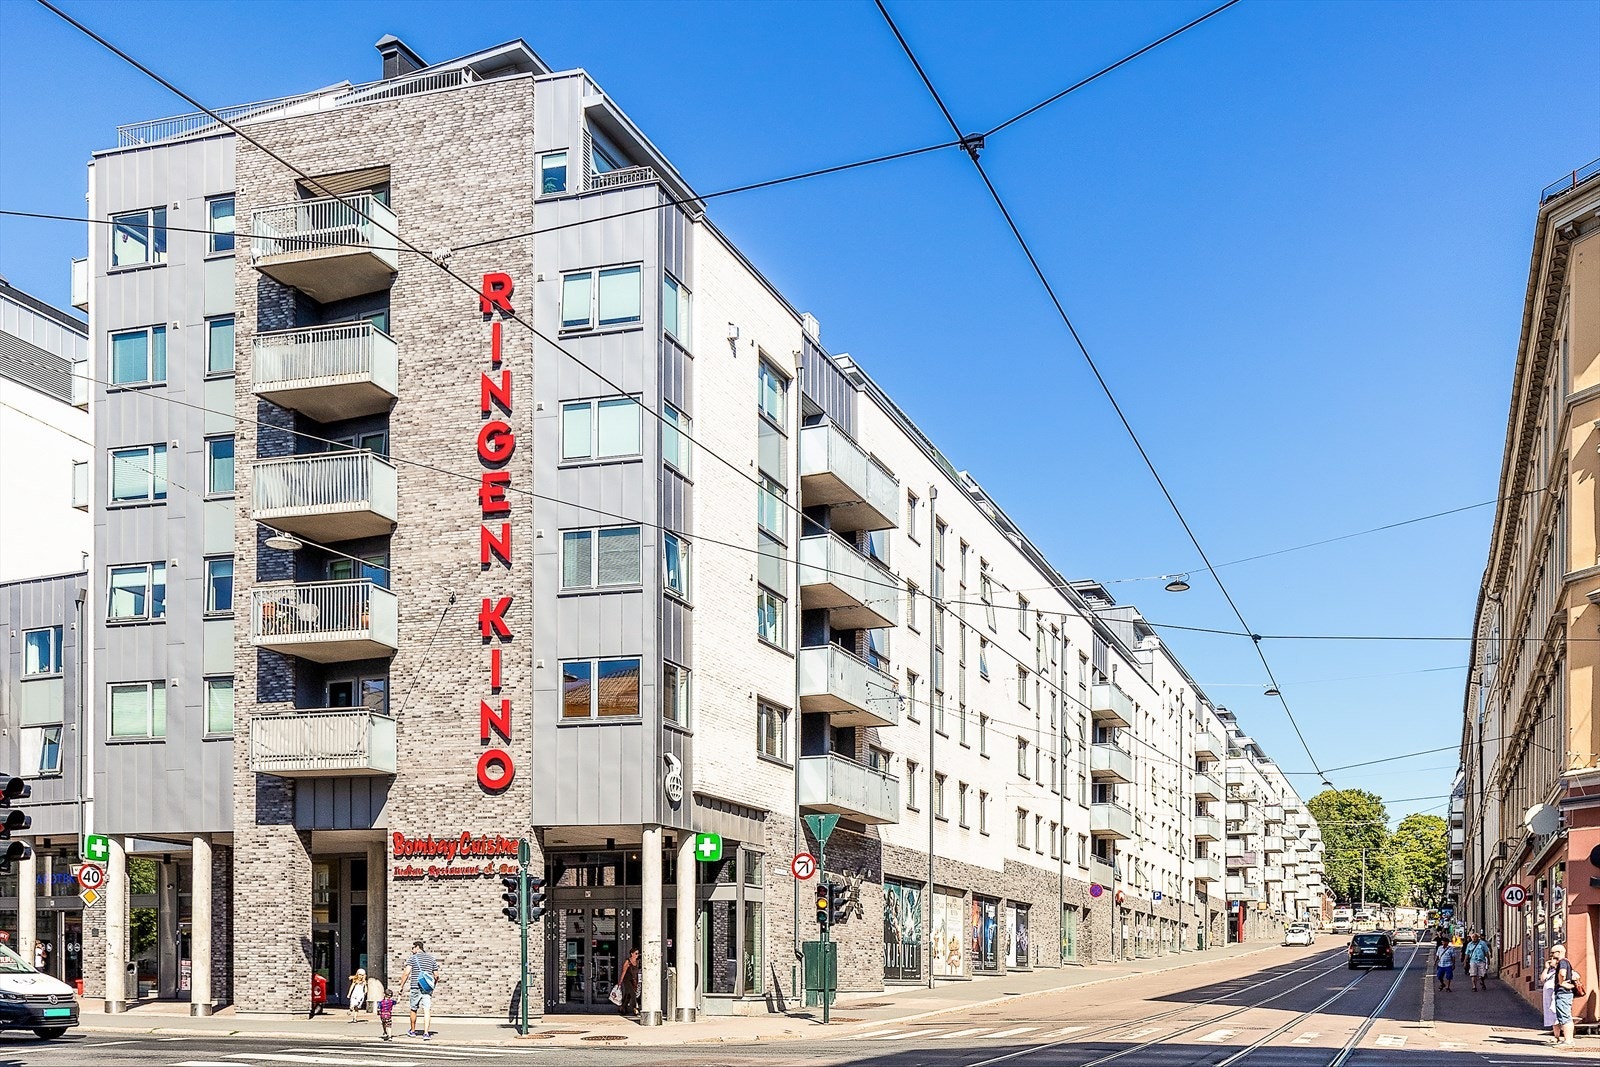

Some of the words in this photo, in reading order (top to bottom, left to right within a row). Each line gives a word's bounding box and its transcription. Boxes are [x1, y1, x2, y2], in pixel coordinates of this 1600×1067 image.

[477, 272, 515, 563] RINGEN
[476, 596, 514, 789] KINO
[393, 831, 457, 861] Bombay
[460, 831, 519, 855] Cuisine
[83, 871, 99, 883] 40
[393, 865, 424, 876] Indian
[428, 865, 480, 877] Restaurant
[1506, 889, 1523, 901] 40
